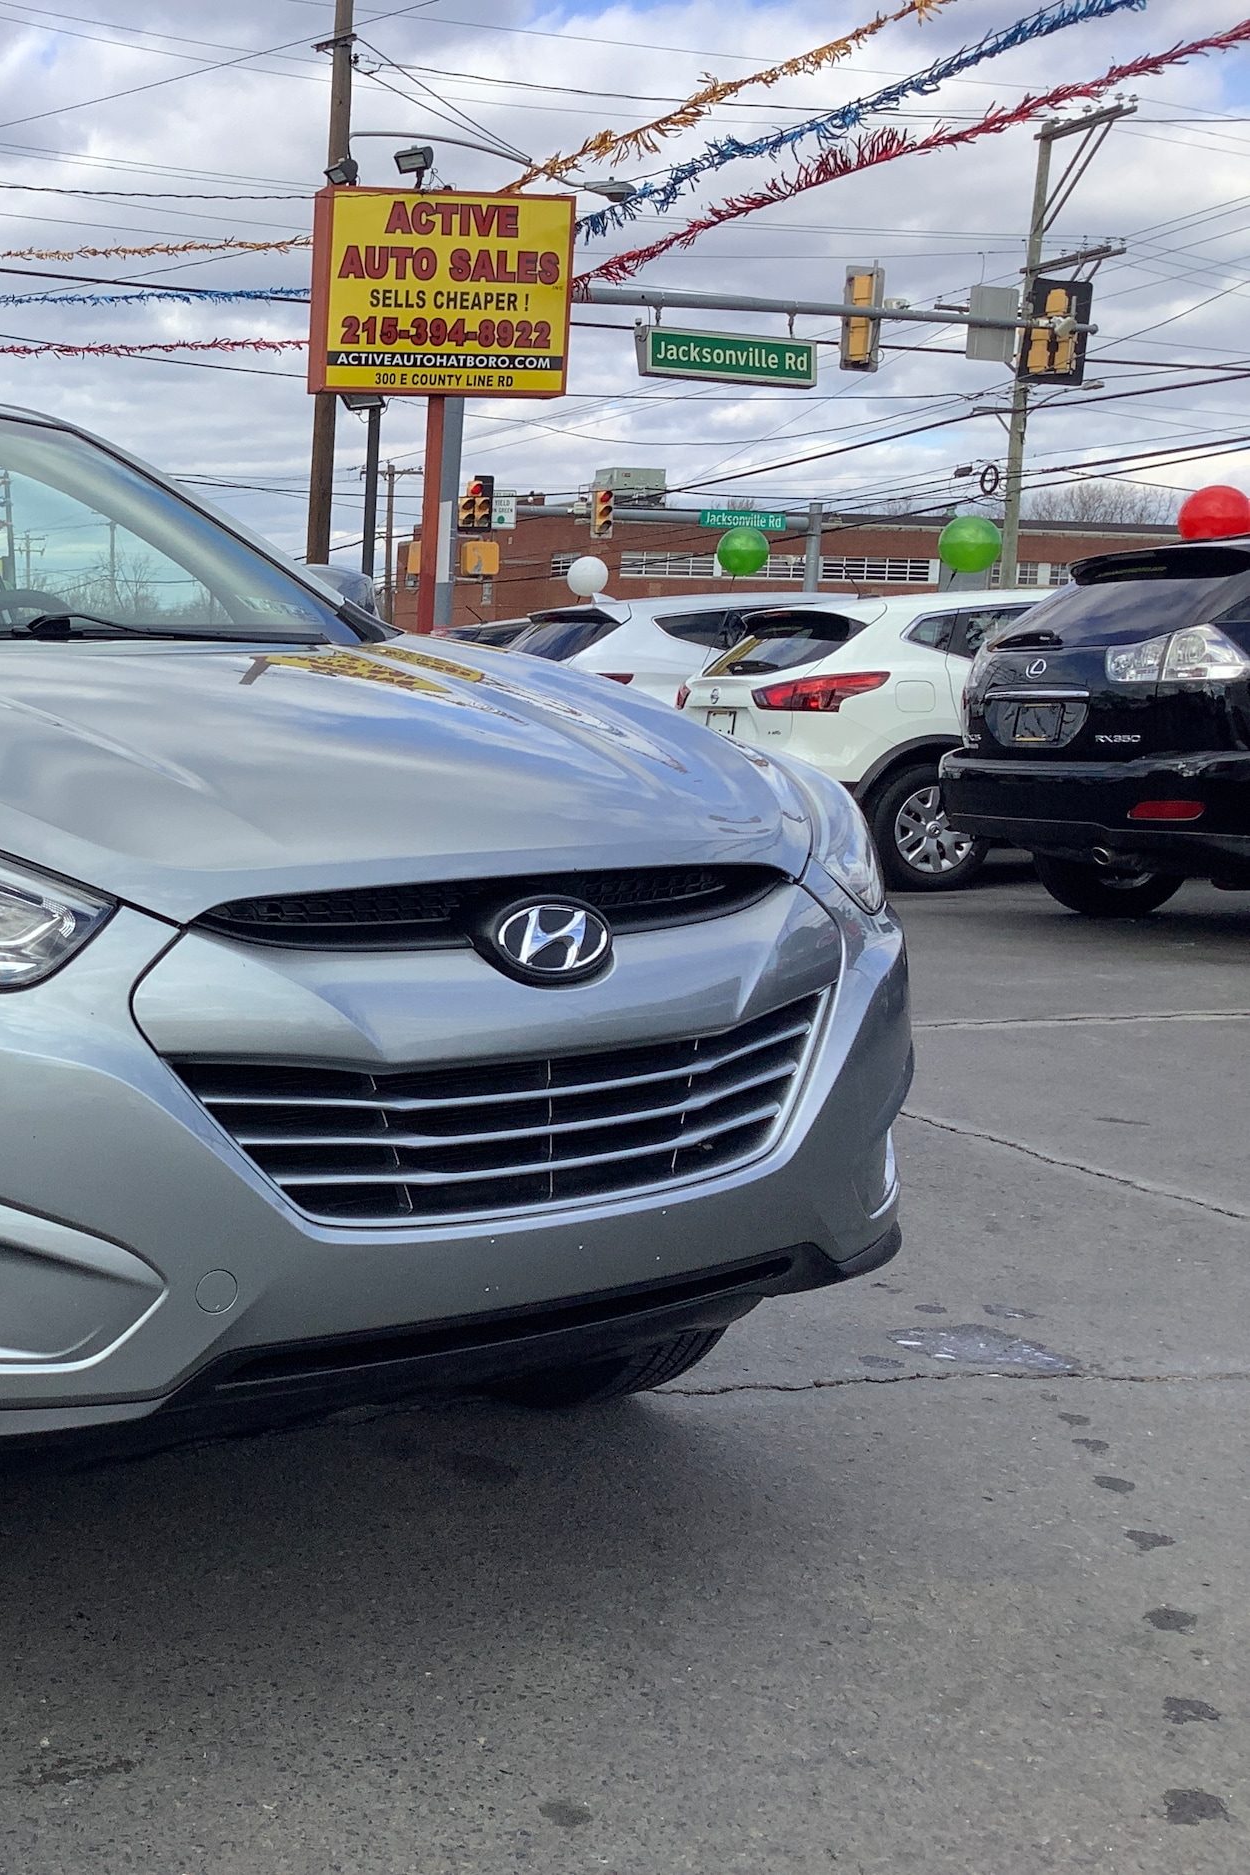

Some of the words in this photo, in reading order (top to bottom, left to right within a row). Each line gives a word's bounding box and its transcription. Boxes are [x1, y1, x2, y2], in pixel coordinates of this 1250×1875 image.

[384, 201, 519, 238] ACTIVE
[337, 245, 438, 280] AUTO
[448, 249, 560, 285] SALES
[369, 288, 427, 309] SELLS
[433, 291, 518, 311] CHEAPER
[340, 316, 551, 349] 215-394-8922
[336, 352, 551, 369] ACTIVEAUTOHATBORO.COM
[656, 341, 779, 369] Jacksonville
[784, 351, 808, 372] Rd
[374, 372, 396, 385] 300
[400, 373, 408, 385] E
[411, 373, 462, 387] COUNTY
[466, 374, 494, 387] LINE
[497, 375, 514, 387] RD
[705, 511, 767, 528] Jacksonville
[767, 514, 782, 529] Rd
[1094, 734, 1141, 743] RX350
